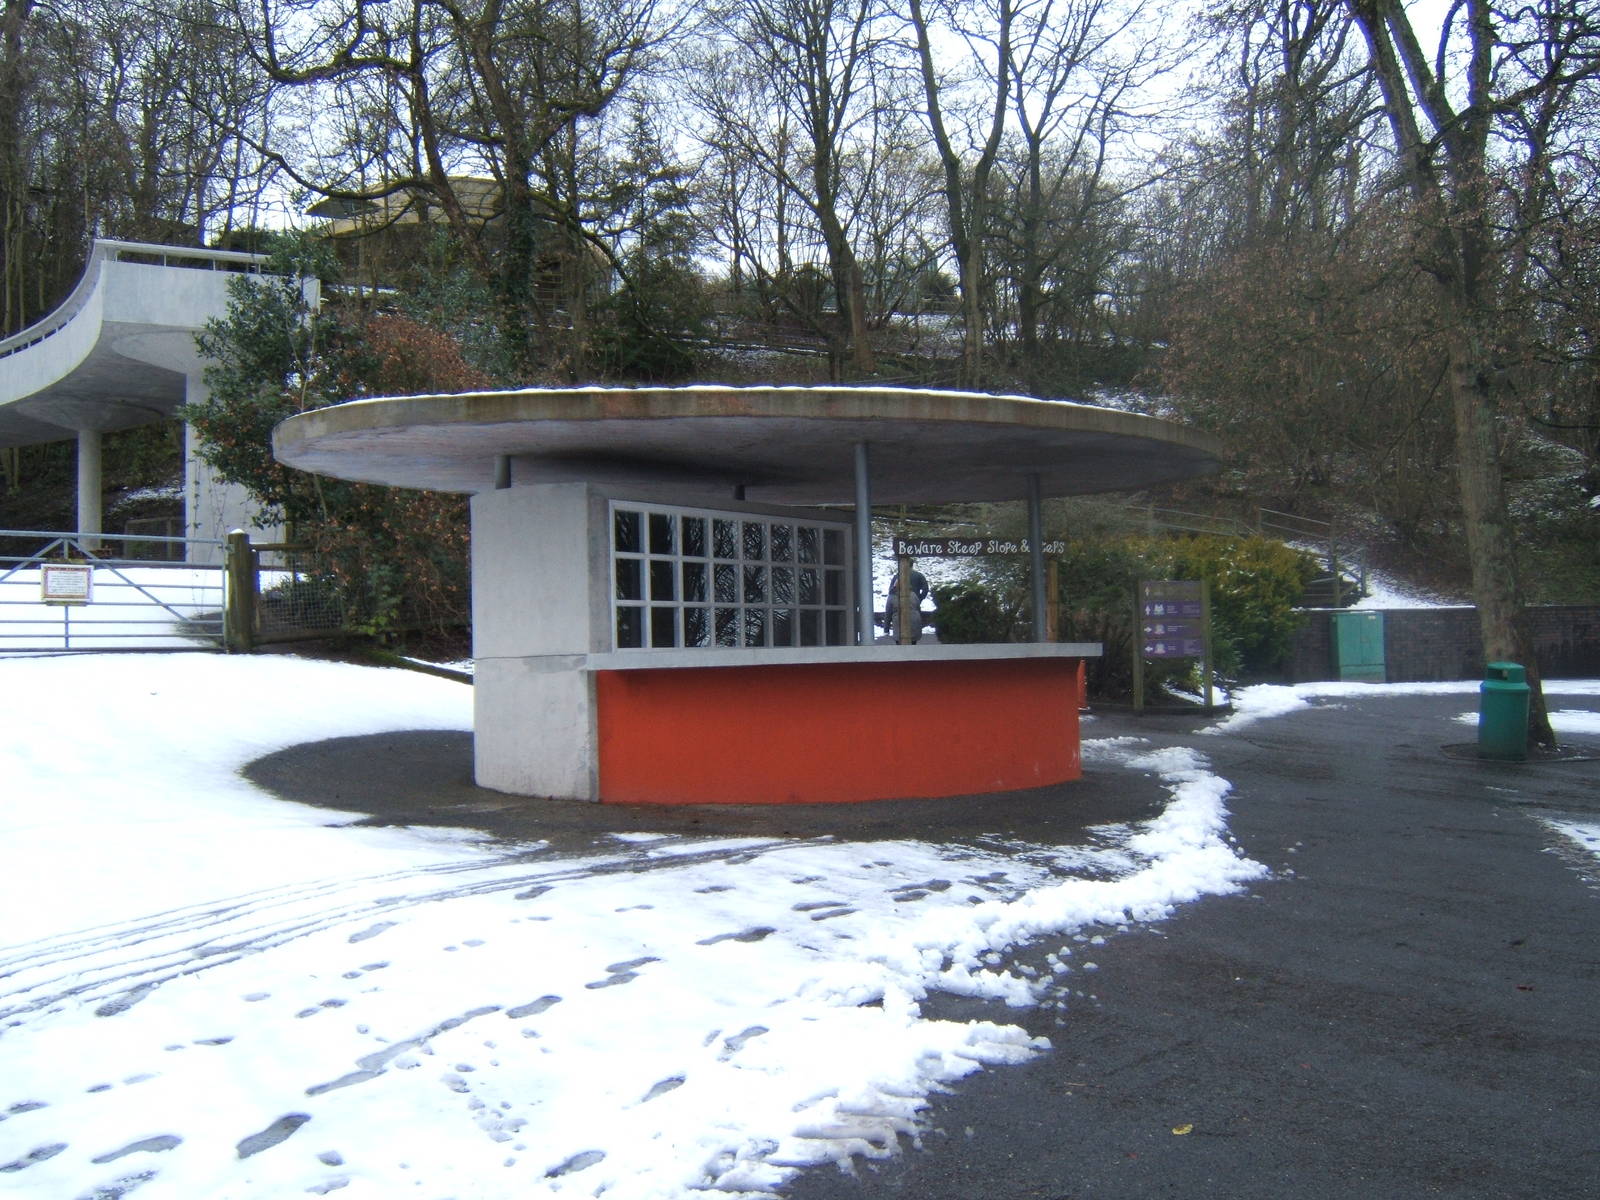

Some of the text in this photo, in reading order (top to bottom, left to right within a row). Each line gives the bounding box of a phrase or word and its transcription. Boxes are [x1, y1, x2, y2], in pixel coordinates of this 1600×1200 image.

[899, 541, 943, 555] Beware
[947, 540, 983, 555] Steep
[986, 540, 1018, 555] Slope
[1020, 539, 1031, 553] &
